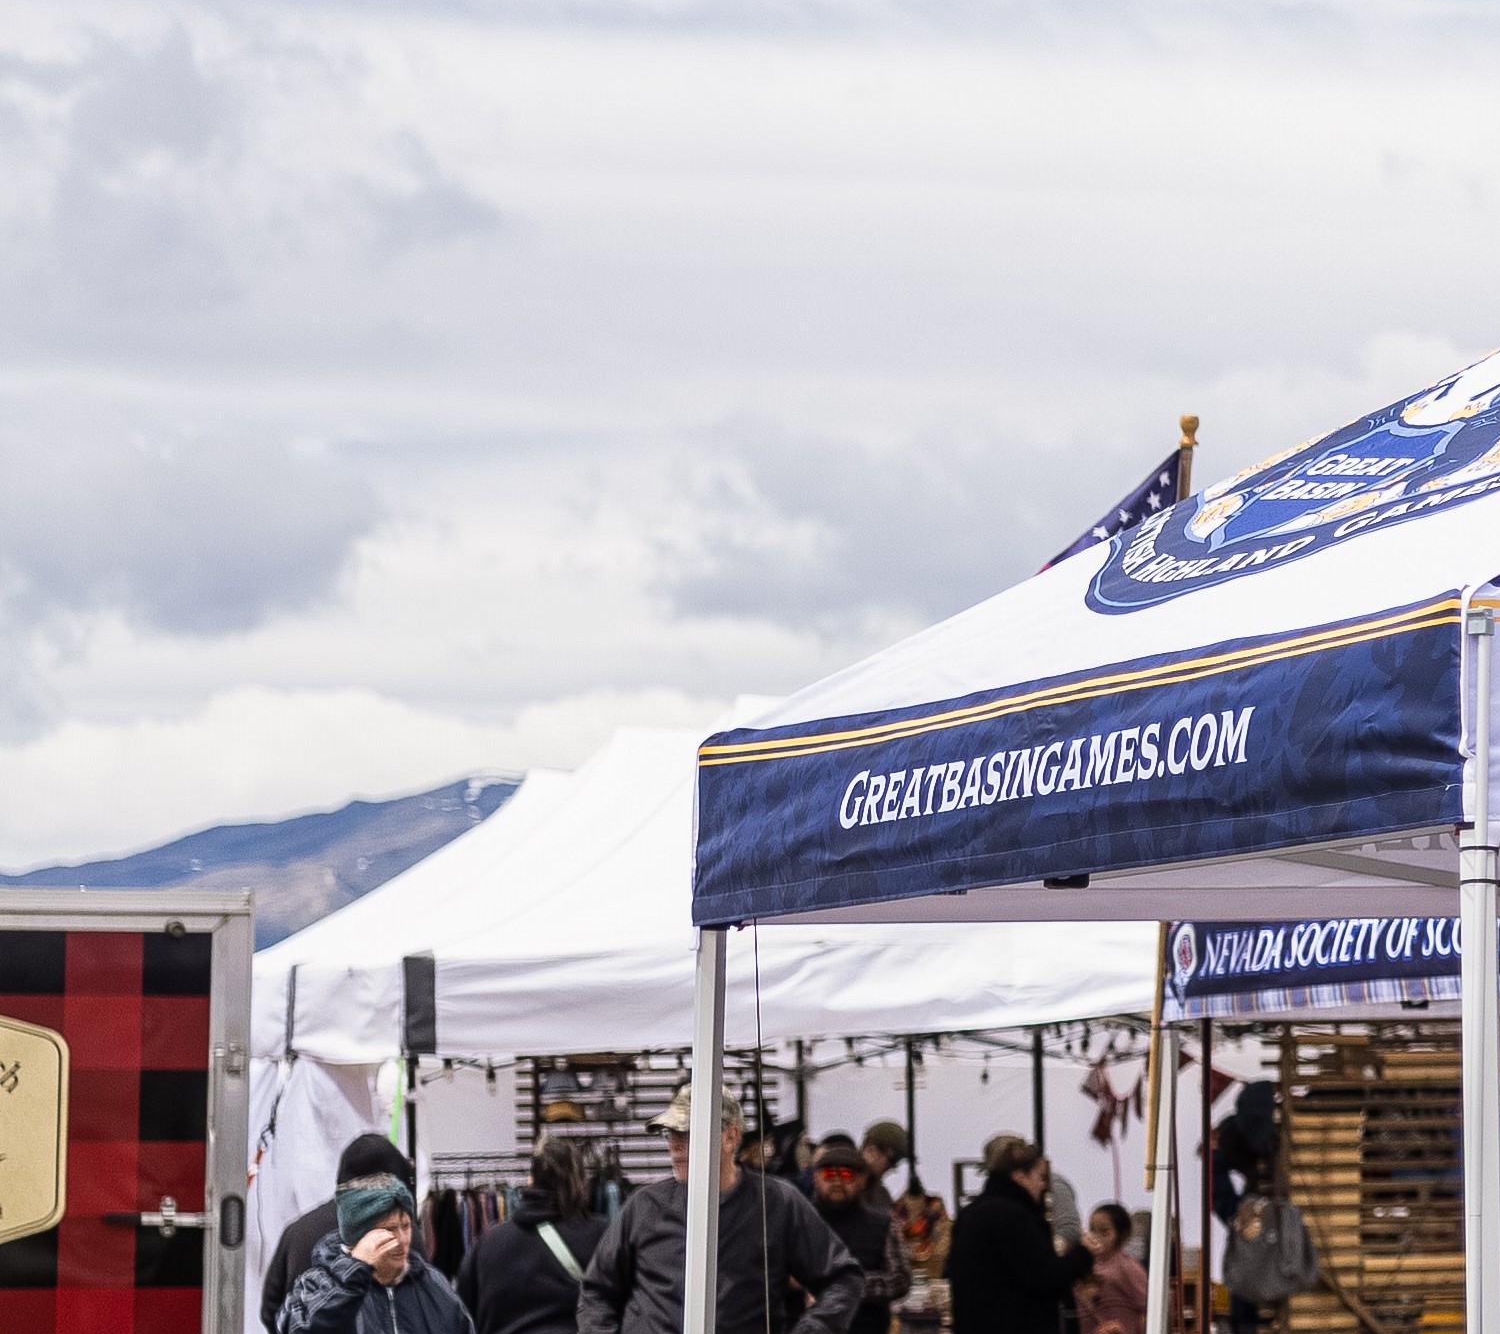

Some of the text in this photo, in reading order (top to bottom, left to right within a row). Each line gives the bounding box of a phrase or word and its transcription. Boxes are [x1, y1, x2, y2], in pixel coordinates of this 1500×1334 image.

[1306, 453, 1416, 476] GREAT
[1260, 479, 1367, 500] BASIN
[1130, 535, 1316, 583] HIGHLAND
[838, 706, 1256, 829] GREATBASINGAMES.COM
[1202, 927, 1282, 976] NEVADA
[1284, 918, 1388, 969] SOCIETY
